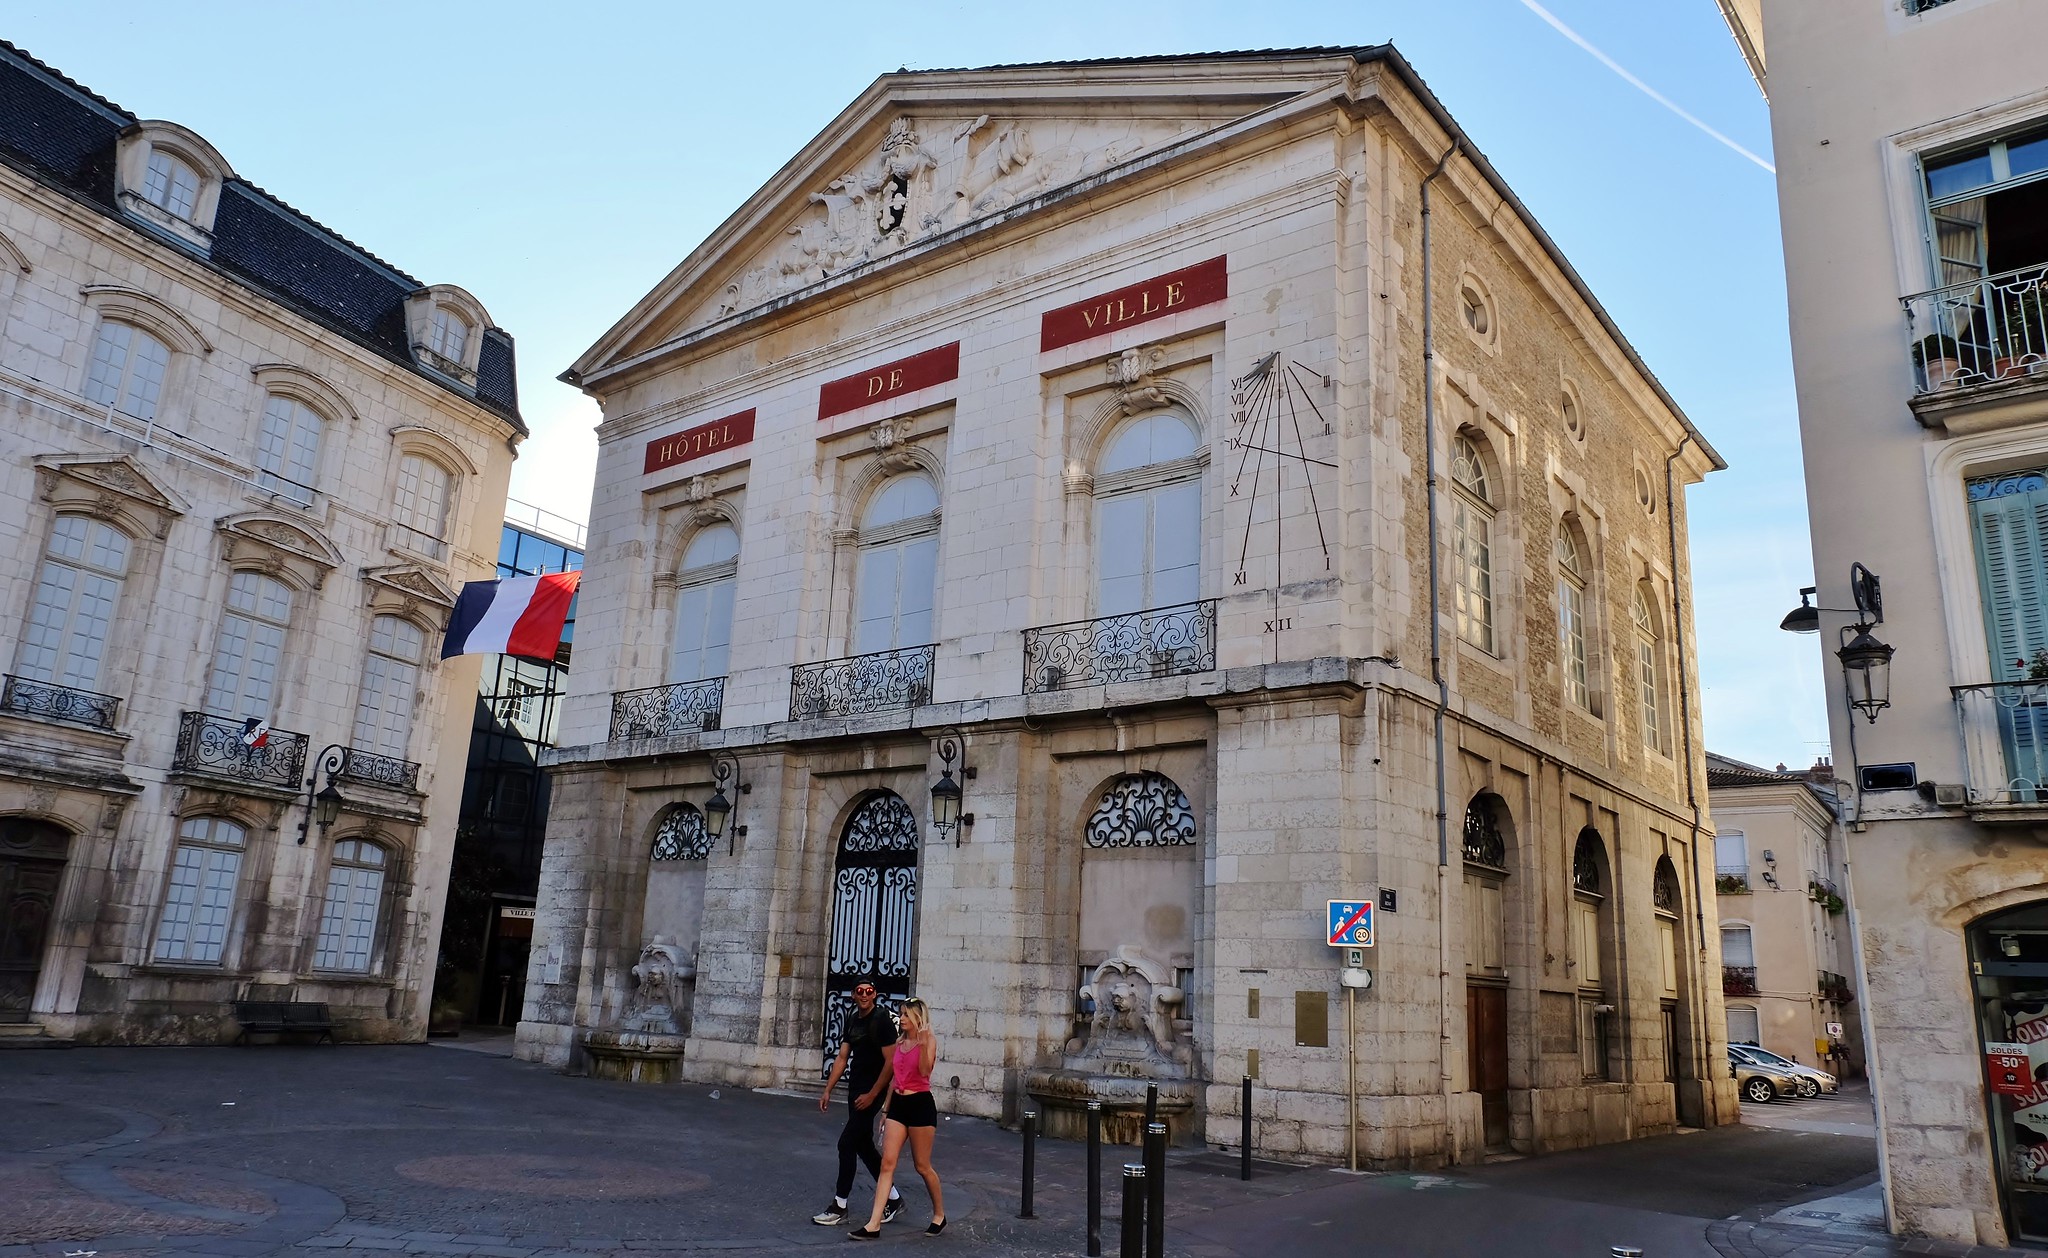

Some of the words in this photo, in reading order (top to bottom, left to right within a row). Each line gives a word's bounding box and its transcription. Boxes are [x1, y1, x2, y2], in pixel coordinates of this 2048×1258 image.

[660, 424, 735, 463] HÔTEL
[866, 368, 904, 398] DE
[1081, 280, 1186, 329] VILLE
[1231, 377, 1242, 390] VI
[1323, 375, 1331, 388] III
[1231, 392, 1244, 405] VII
[1230, 410, 1246, 424] VIII
[1325, 423, 1331, 436] II
[1230, 436, 1242, 451] IX
[1230, 483, 1240, 497] X
[1233, 571, 1247, 586] XI
[510, 909, 530, 917] VILLE
[1357, 931, 1367, 939] 20
[2007, 1017, 2048, 1043] OLD
[1991, 1046, 2023, 1055] SOLDES
